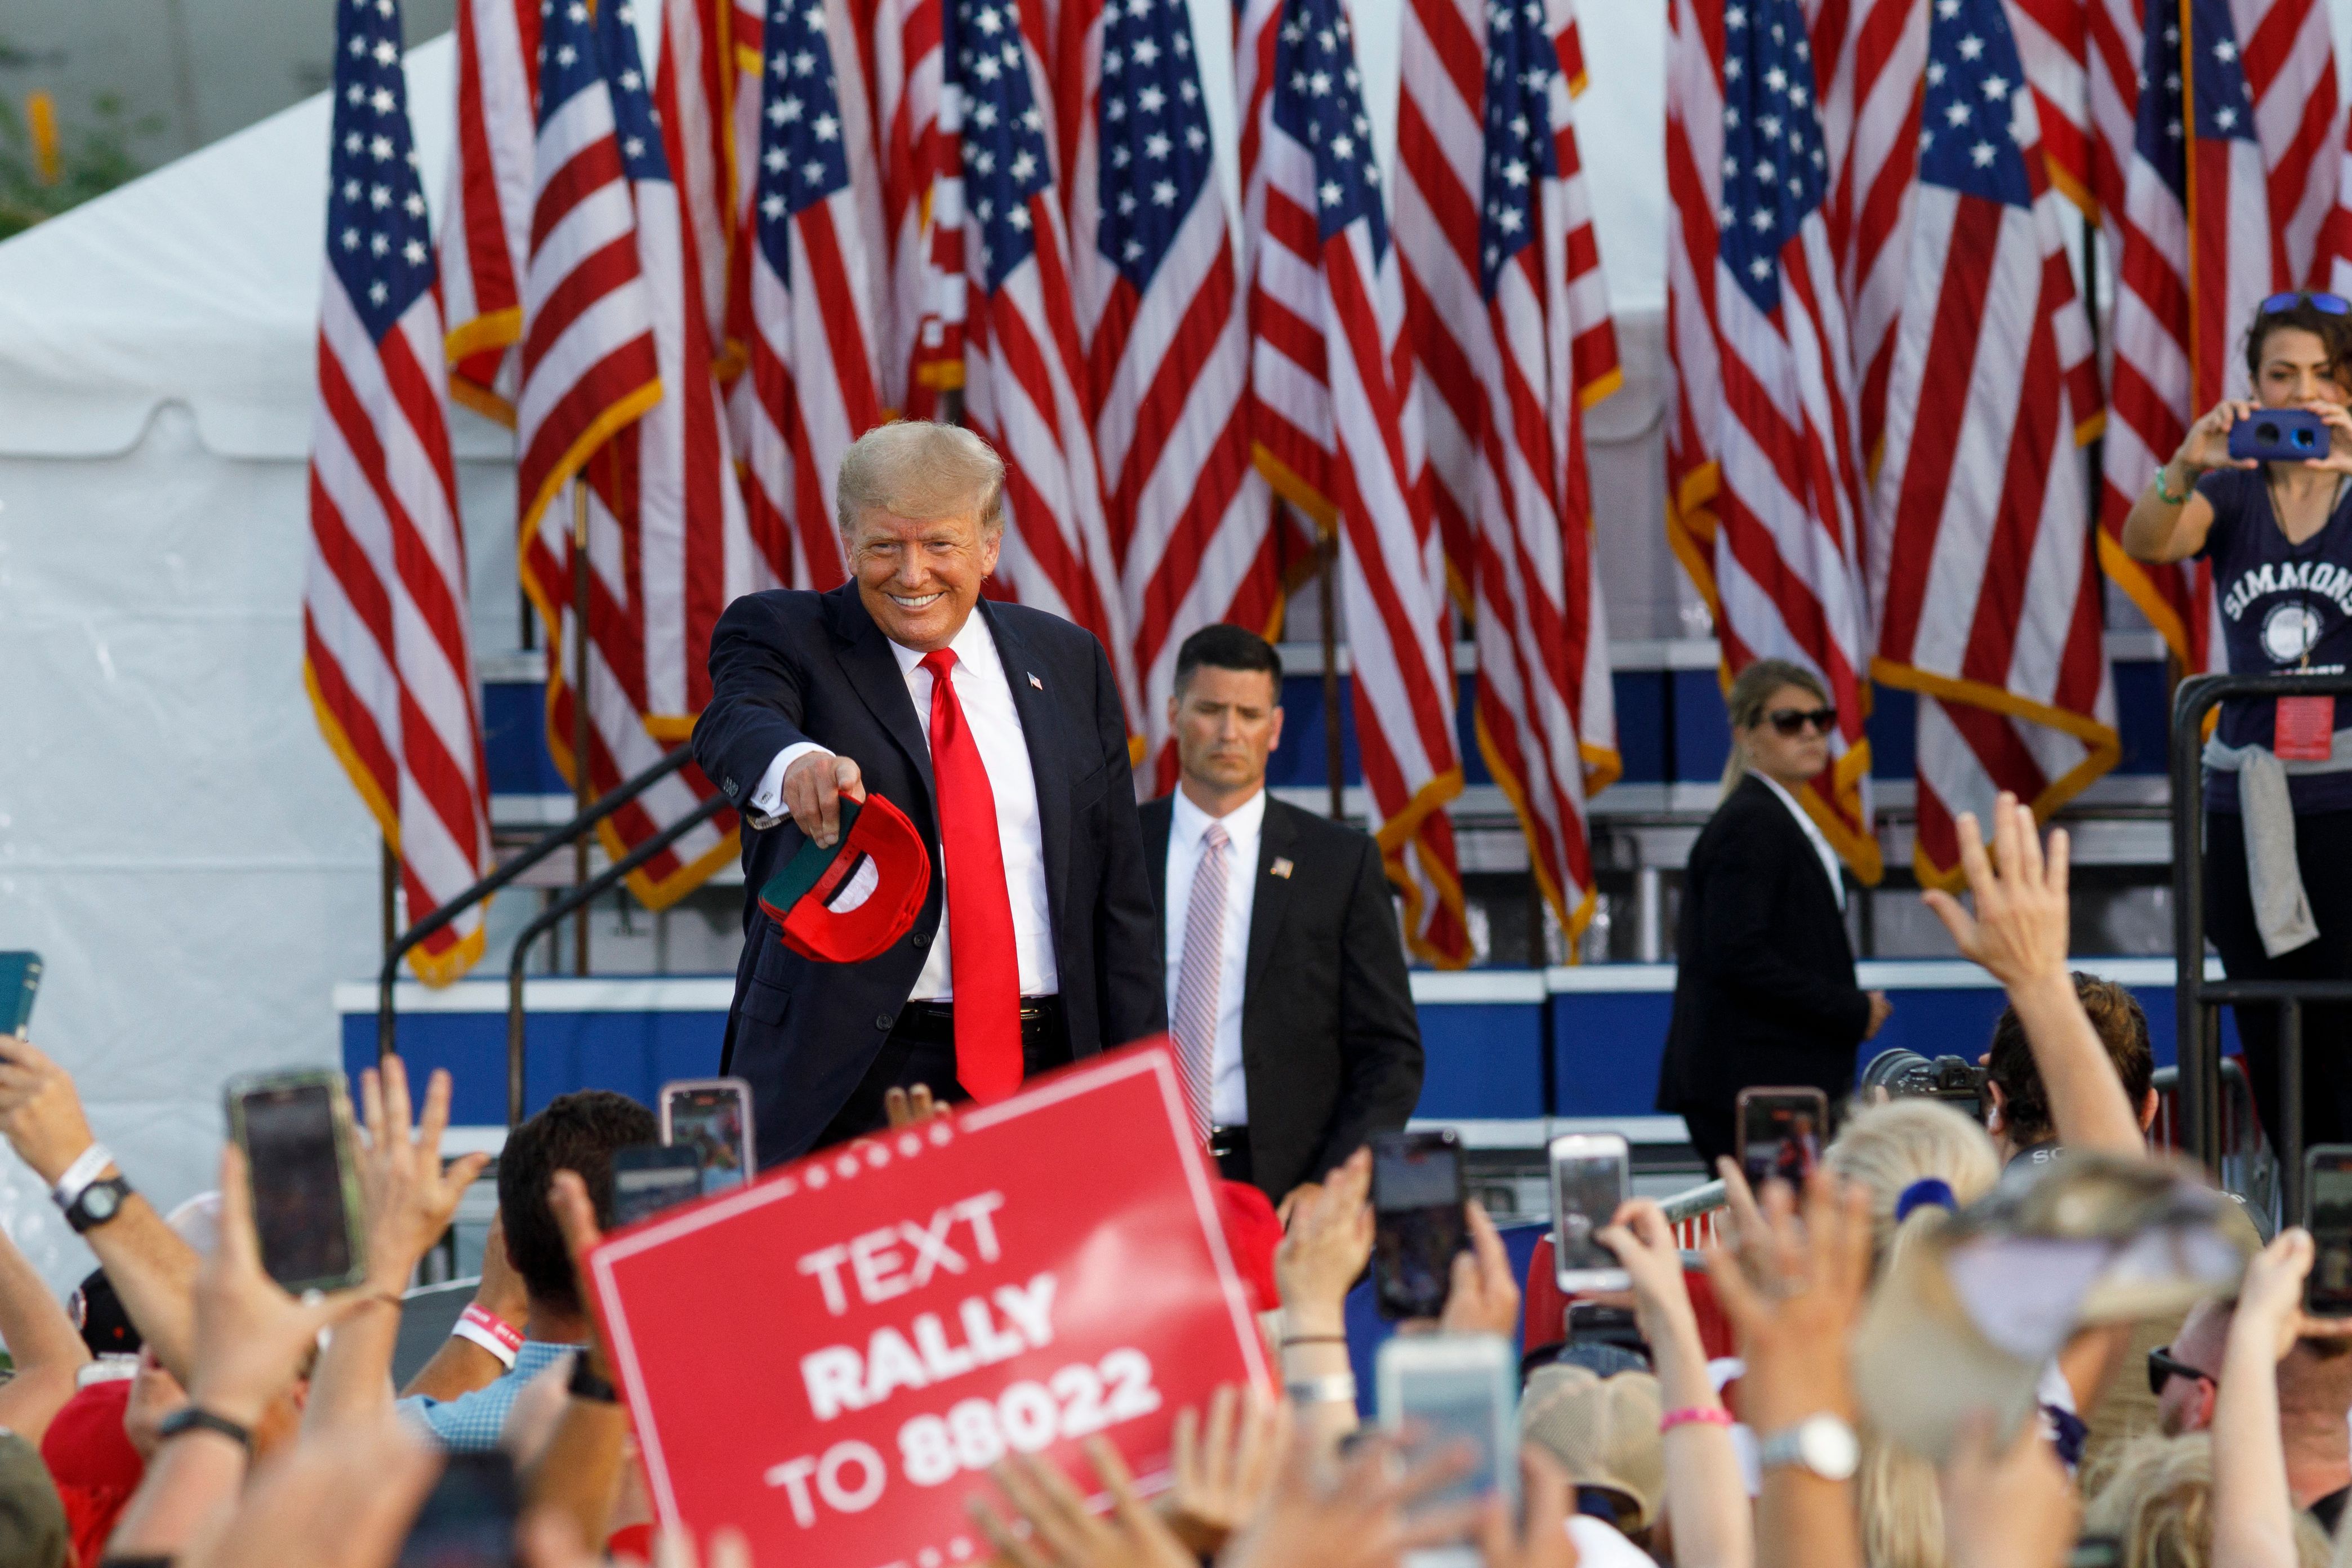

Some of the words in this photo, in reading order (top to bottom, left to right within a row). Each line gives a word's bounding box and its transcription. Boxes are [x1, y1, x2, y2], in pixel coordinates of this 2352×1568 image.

[797, 1190, 1004, 1315] TEXT
[799, 1271, 1059, 1421] RALLY
[765, 1440, 887, 1527] TO
[897, 1346, 1162, 1487] 88022
